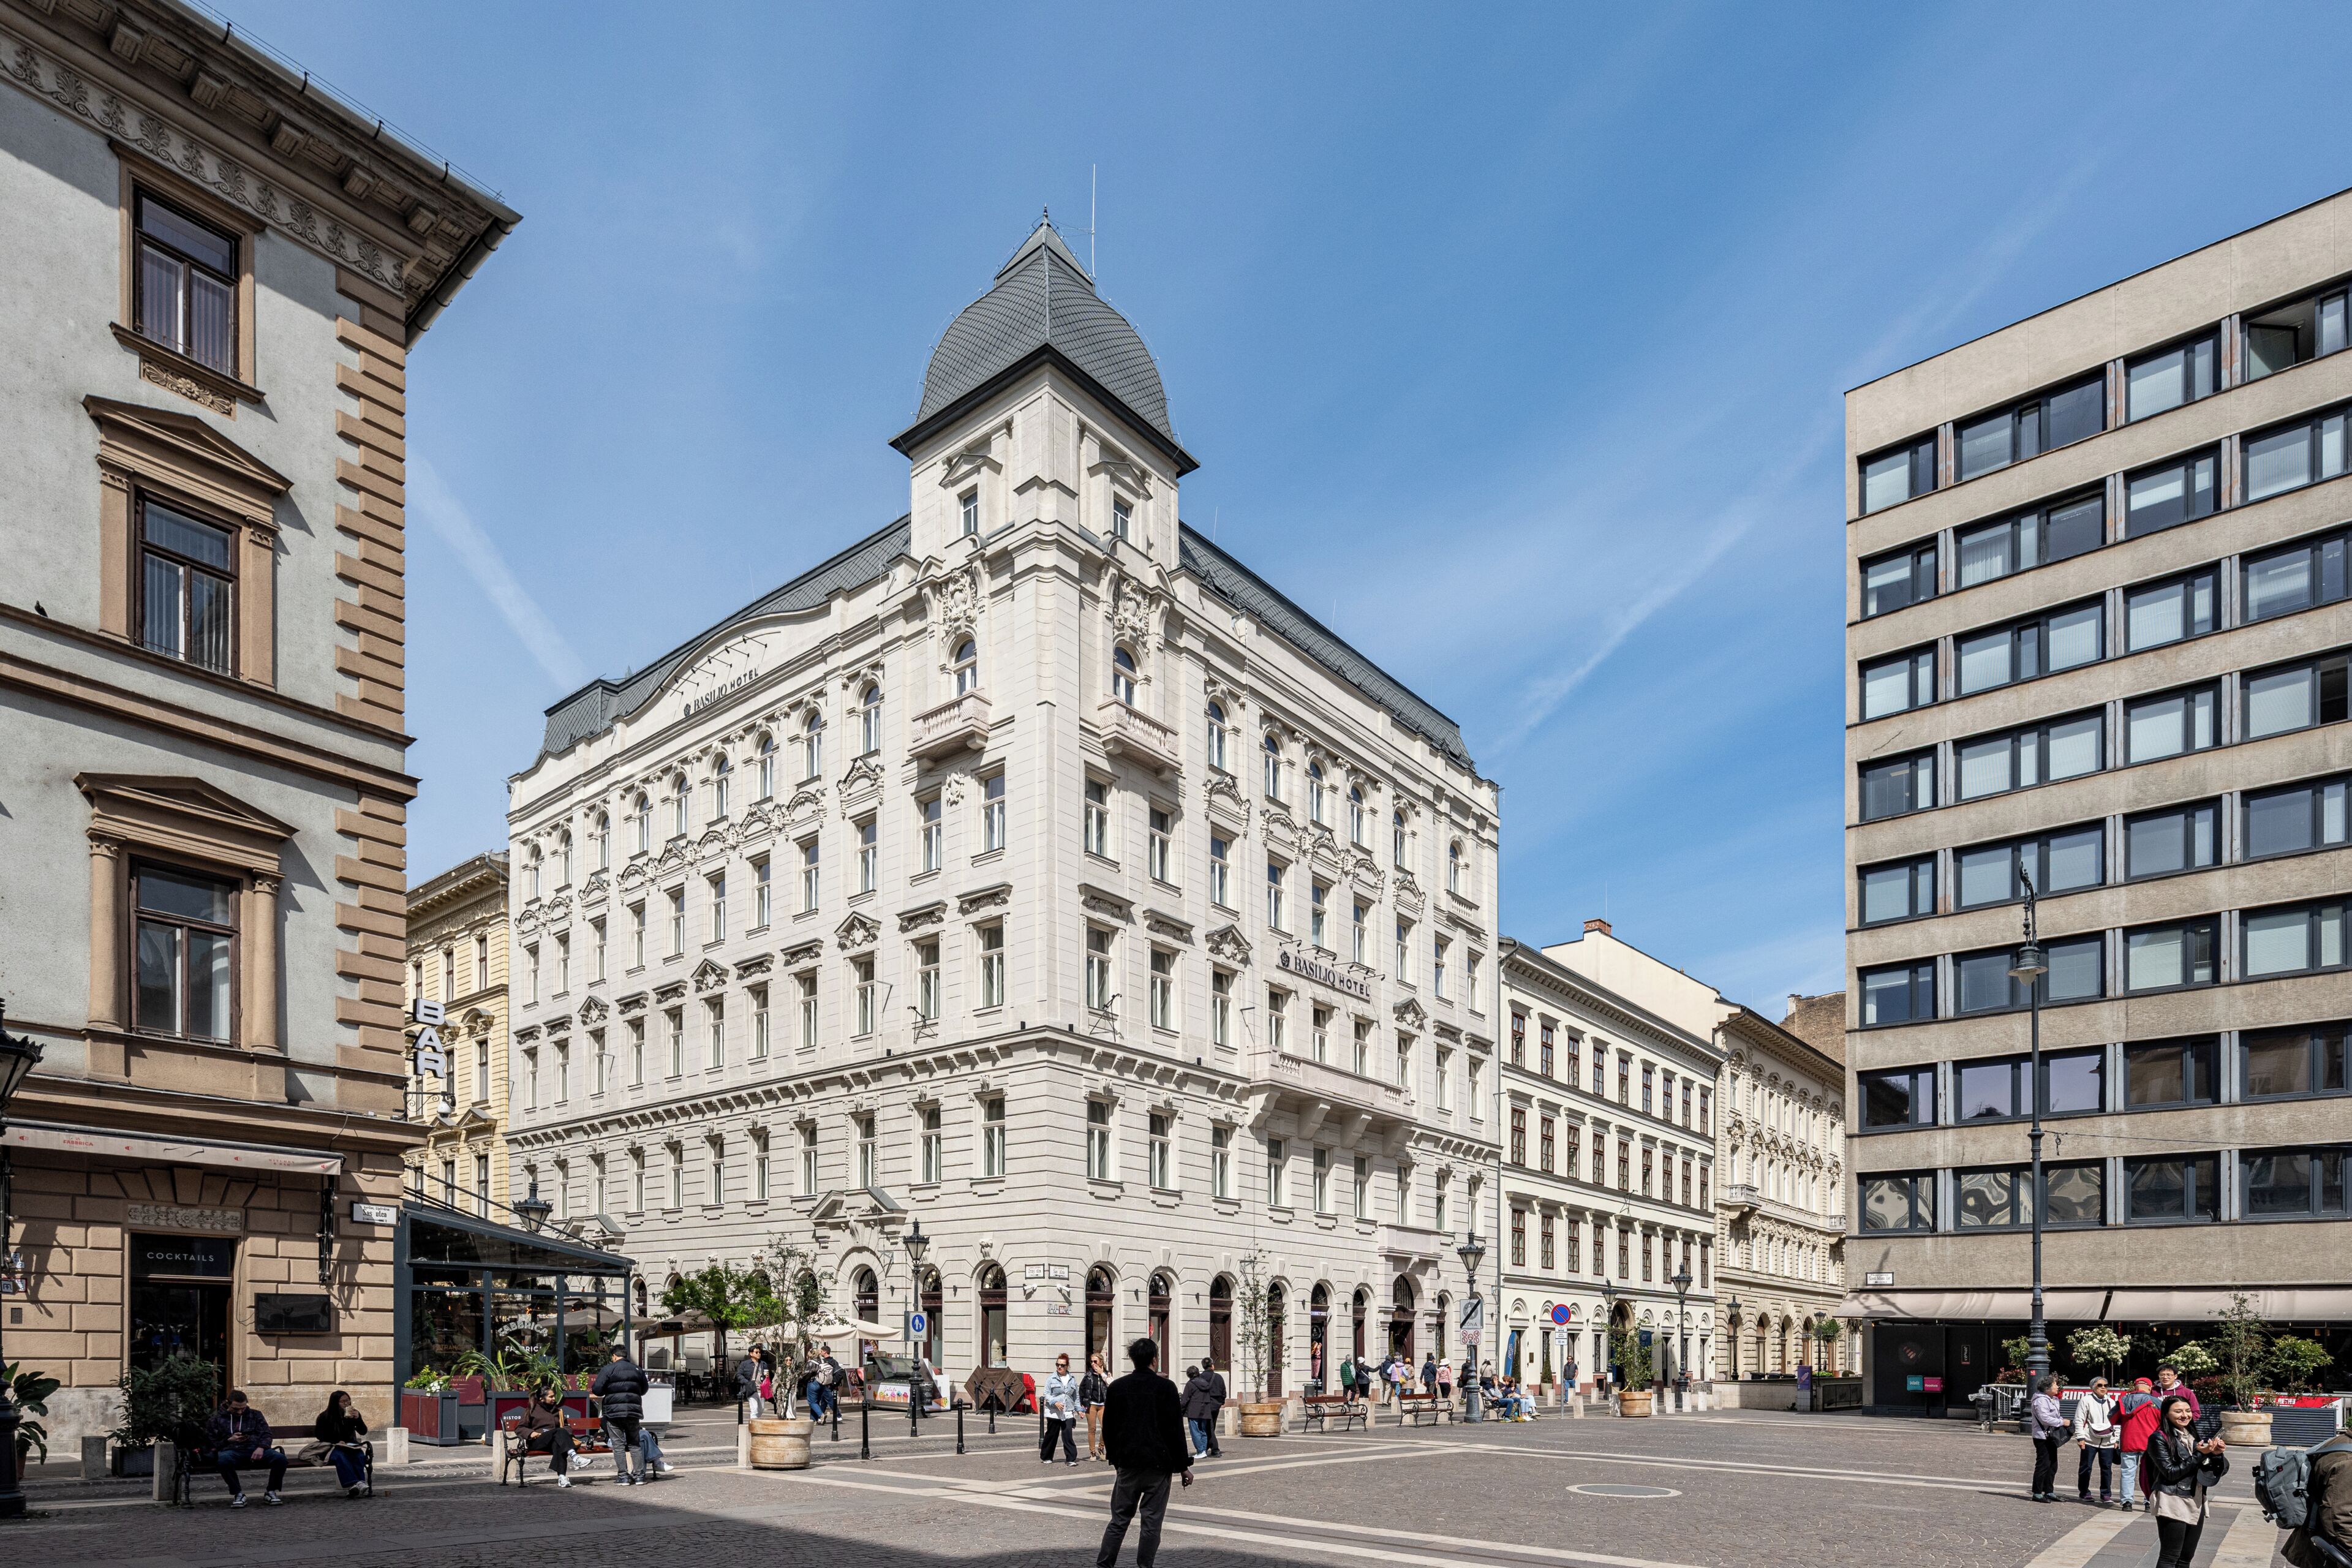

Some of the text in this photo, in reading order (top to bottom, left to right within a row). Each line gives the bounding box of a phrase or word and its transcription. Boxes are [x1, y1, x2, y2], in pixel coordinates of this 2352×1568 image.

[731, 668, 758, 690] HOTEL
[1340, 974, 1370, 997] HOTEL
[415, 998, 447, 1079] BAR
[147, 1252, 214, 1262] COCKTAILS
[497, 1321, 548, 1336] FABBRICA
